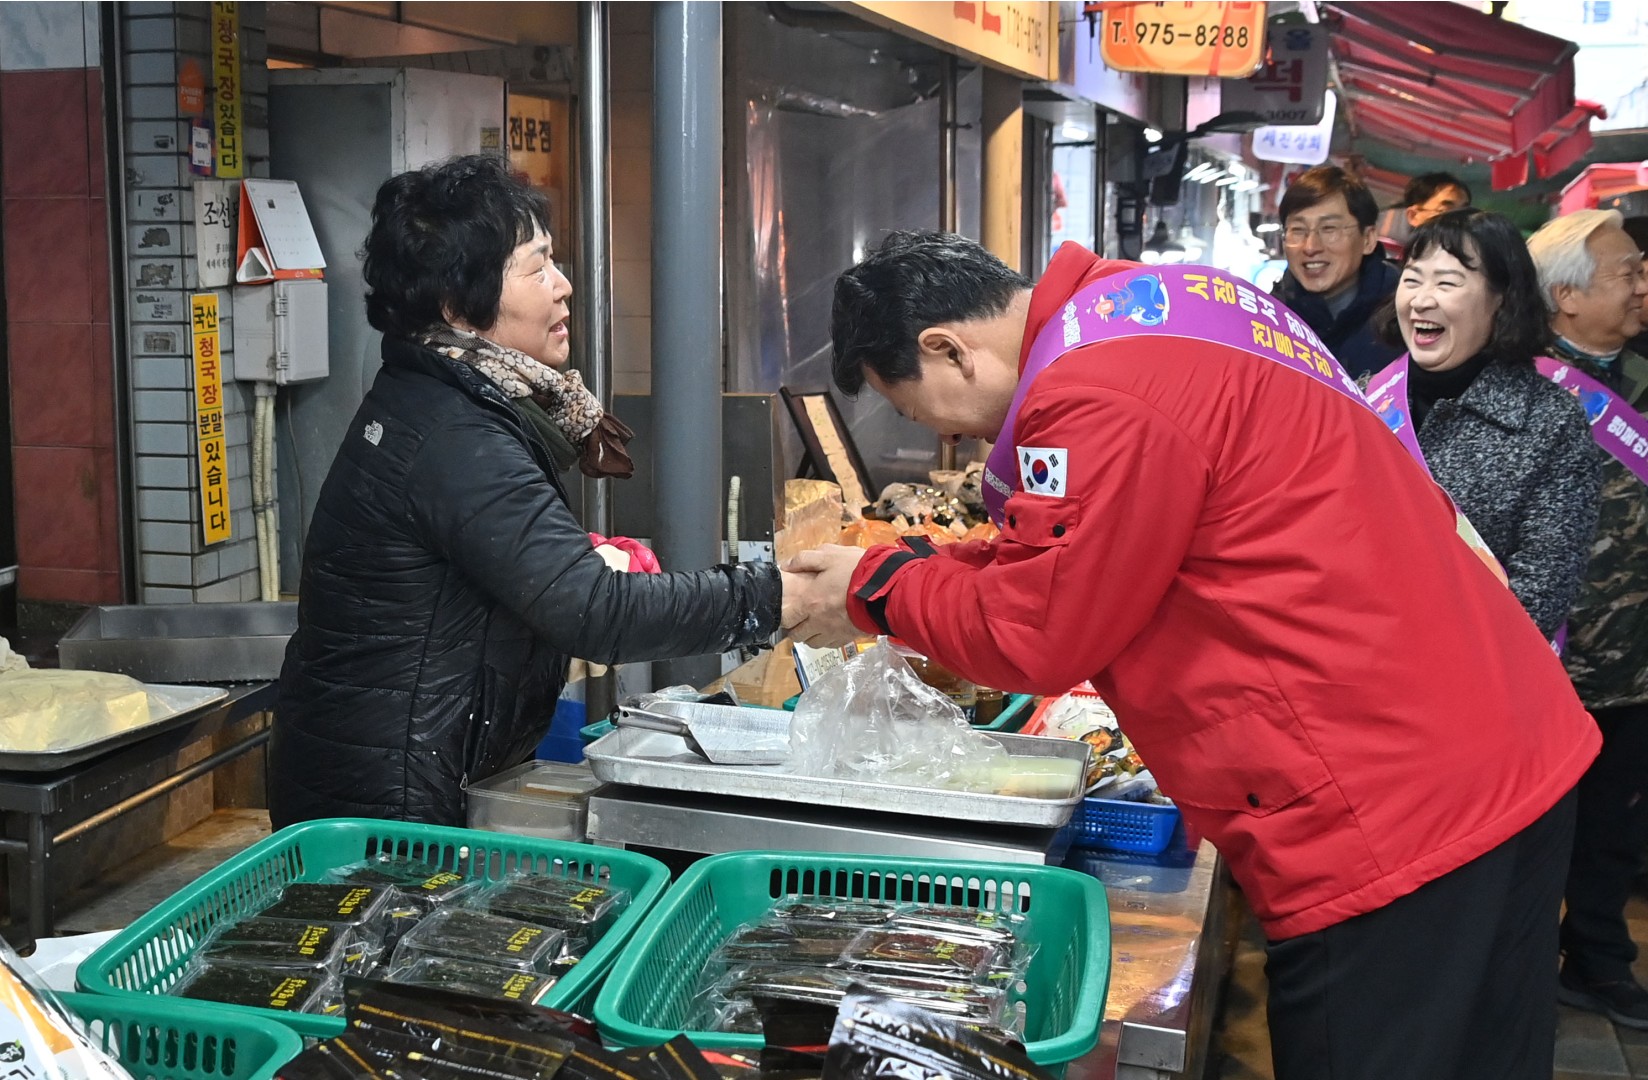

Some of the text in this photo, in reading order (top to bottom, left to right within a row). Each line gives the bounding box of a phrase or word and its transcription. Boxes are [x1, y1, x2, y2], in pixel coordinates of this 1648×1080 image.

[217, 18, 236, 101] 청국장
[1112, 22, 1249, 48] T. 975-8288
[219, 103, 238, 169] 있습니다
[510, 116, 551, 153] 전문점
[194, 304, 217, 329] 국산
[1183, 273, 1279, 327] 시장에서
[200, 337, 218, 405] 청국장
[1253, 320, 1333, 379] 전통시장
[200, 411, 222, 435] 분말
[205, 442, 226, 531] 있습니다
